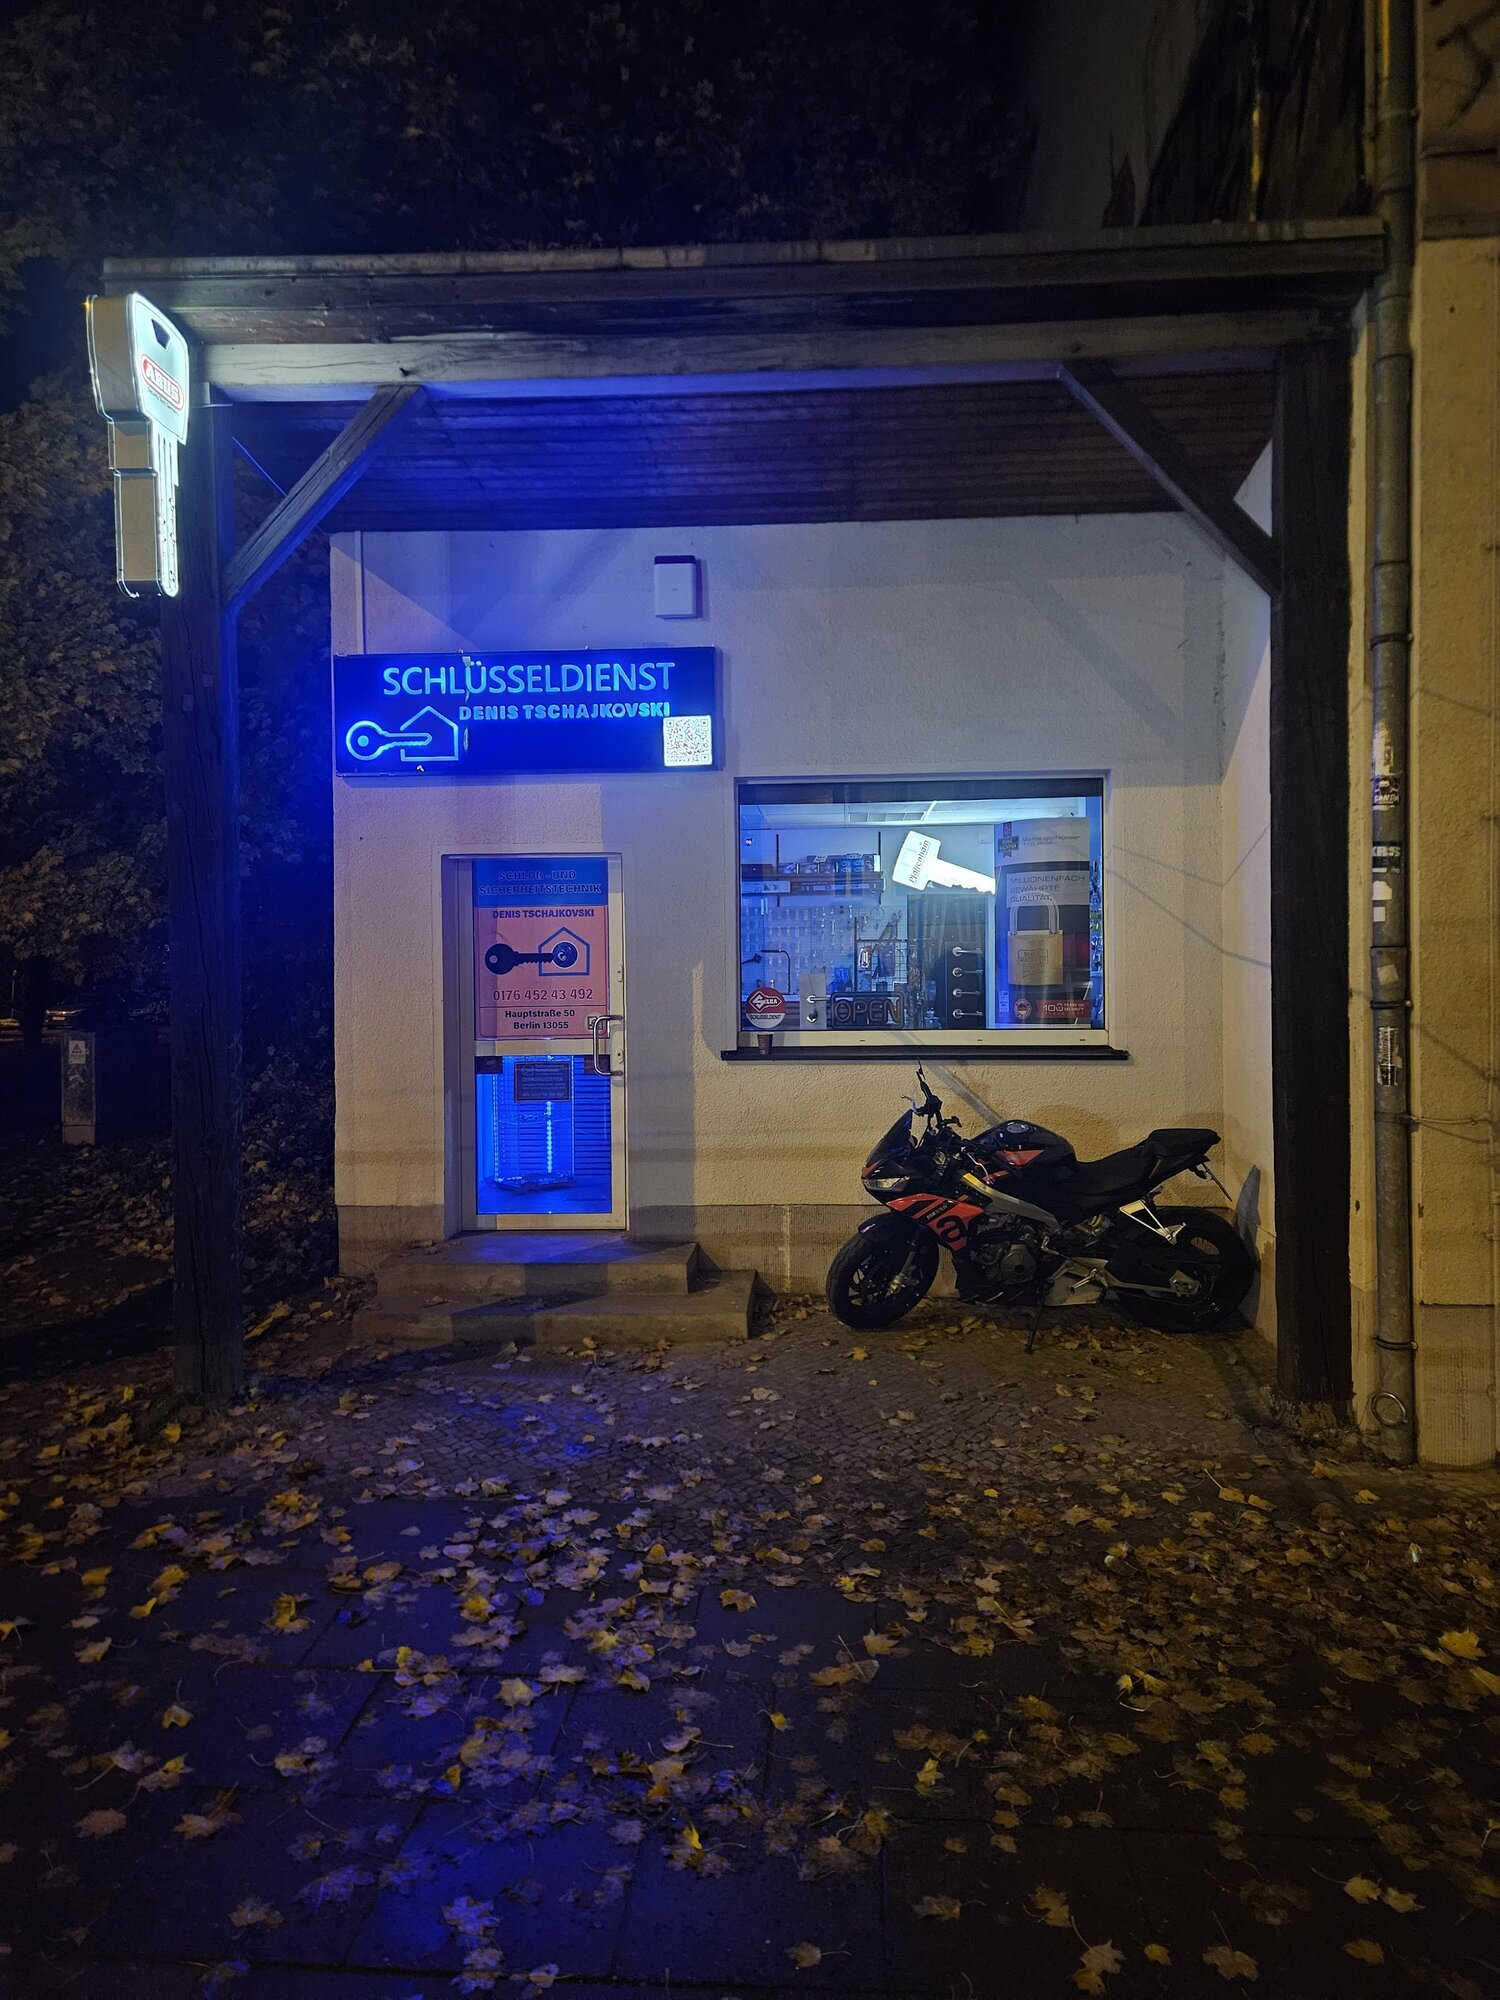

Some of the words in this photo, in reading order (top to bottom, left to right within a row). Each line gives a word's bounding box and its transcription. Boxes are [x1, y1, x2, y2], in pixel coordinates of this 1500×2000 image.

[145, 361, 180, 403] ABUS
[383, 660, 675, 695] SCHLÜSSELDIENST
[459, 705, 518, 721] DENIS
[522, 702, 670, 720] TSCHAJKOVSKI
[552, 870, 577, 880] UND
[1011, 875, 1086, 884] MILLIONENFACH
[480, 884, 602, 895] SICHERHEITSTECHNIK
[492, 910, 521, 919] DENIS
[522, 908, 595, 918] TSCHAJKOVSKI
[493, 990, 521, 1001] 0176
[524, 989, 548, 1000] 452
[551, 989, 567, 1000] 43
[570, 988, 593, 999] 492
[505, 1010, 562, 1020] Hauptstraße
[834, 999, 901, 1023] OPEN
[513, 1021, 541, 1029] Berlin
[543, 1021, 569, 1029] 13055
